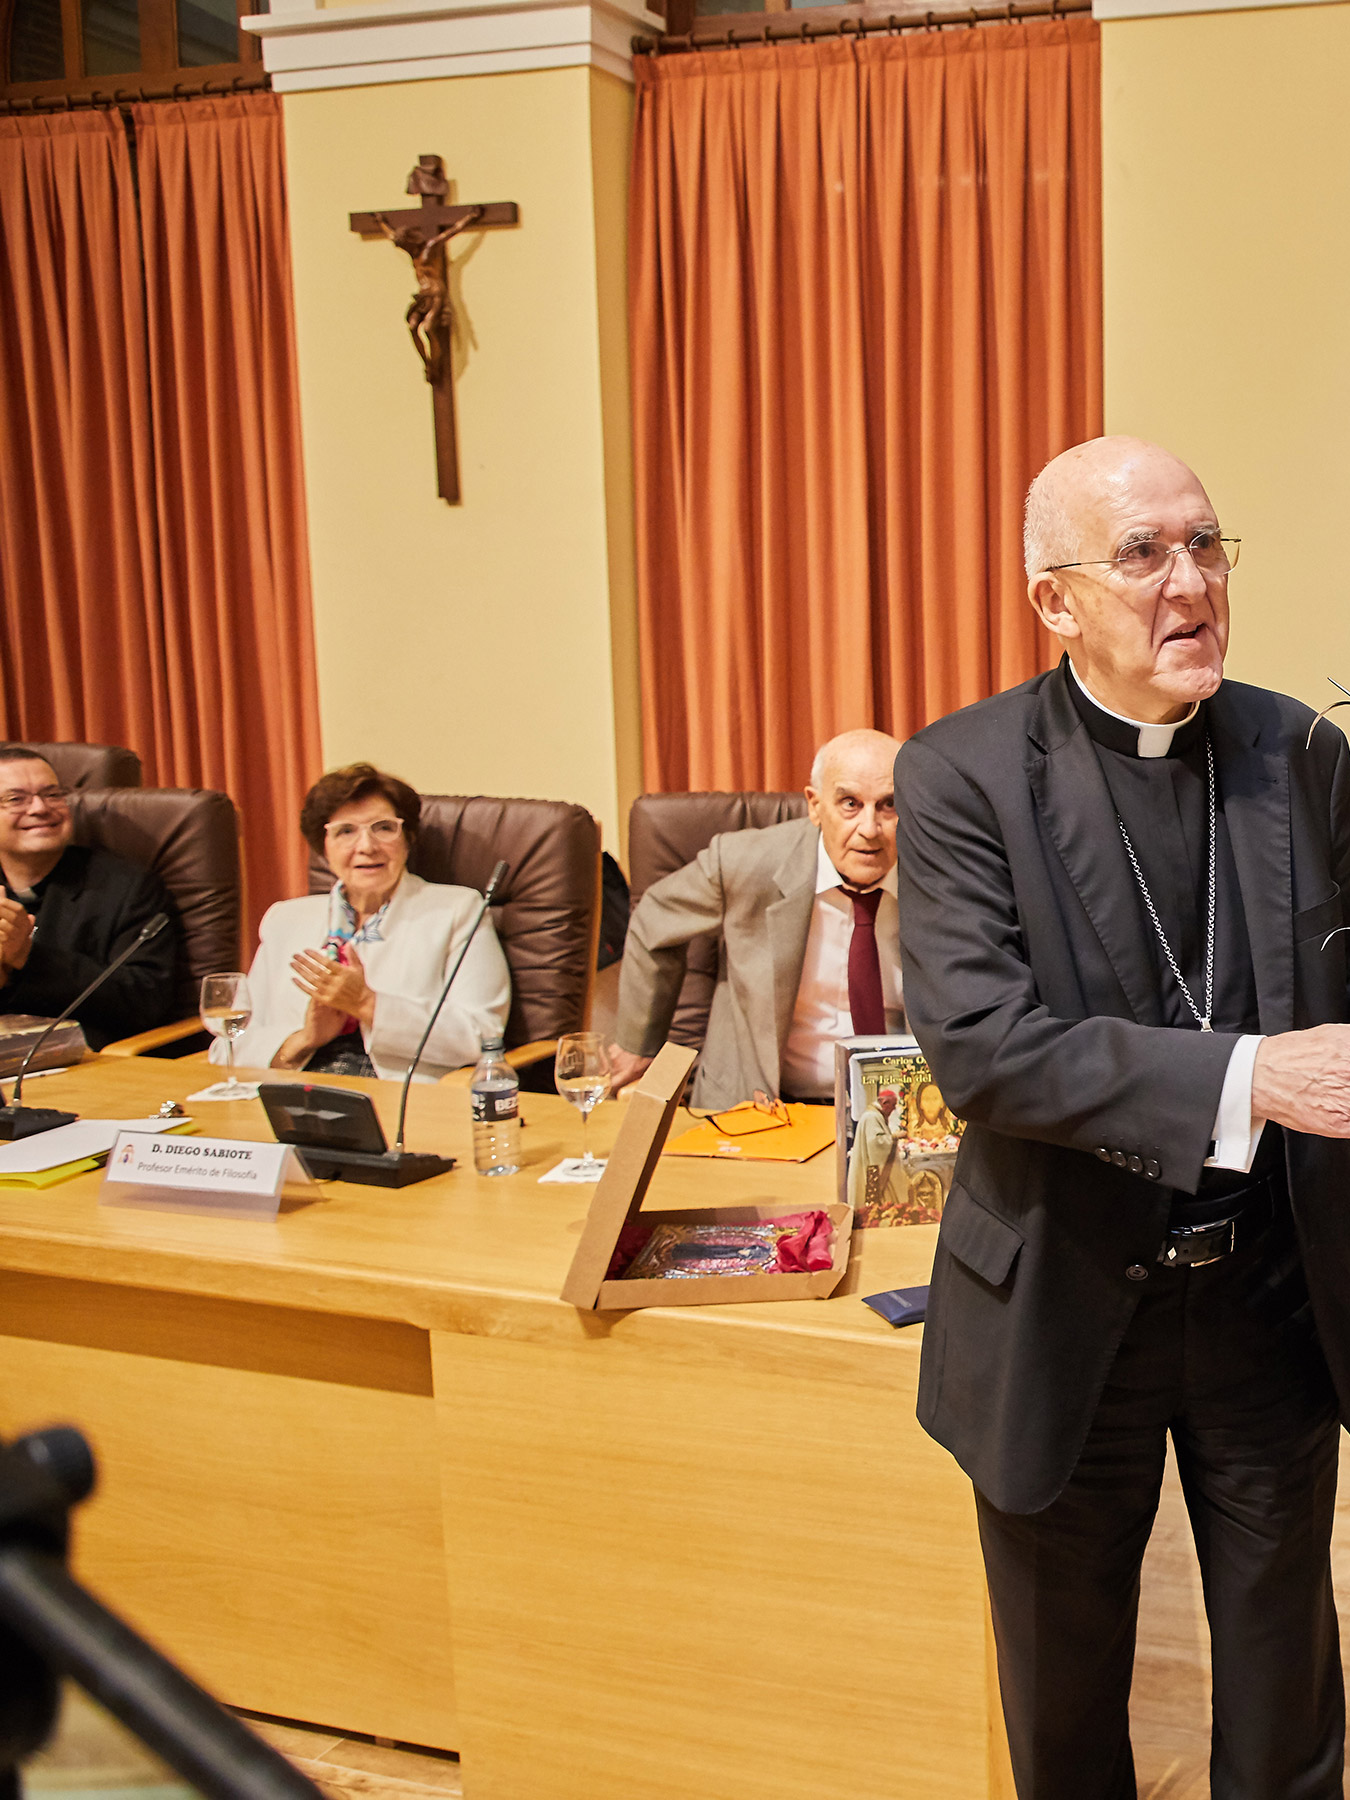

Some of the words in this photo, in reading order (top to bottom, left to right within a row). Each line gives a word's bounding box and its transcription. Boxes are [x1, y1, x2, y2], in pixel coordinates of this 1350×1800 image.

[883, 1056, 913, 1065] Carlos
[915, 1055, 926, 1064] O
[862, 1076, 875, 1085] La
[879, 1074, 912, 1085] Iglesia
[916, 1073, 932, 1083] del
[152, 1144, 163, 1153] D.
[165, 1145, 201, 1156] DIEGO
[203, 1147, 252, 1160] SABIOTE
[137, 1161, 173, 1173] Profesor
[174, 1164, 208, 1176] Emérito
[209, 1168, 220, 1177] de
[222, 1168, 258, 1180] Filosofía
